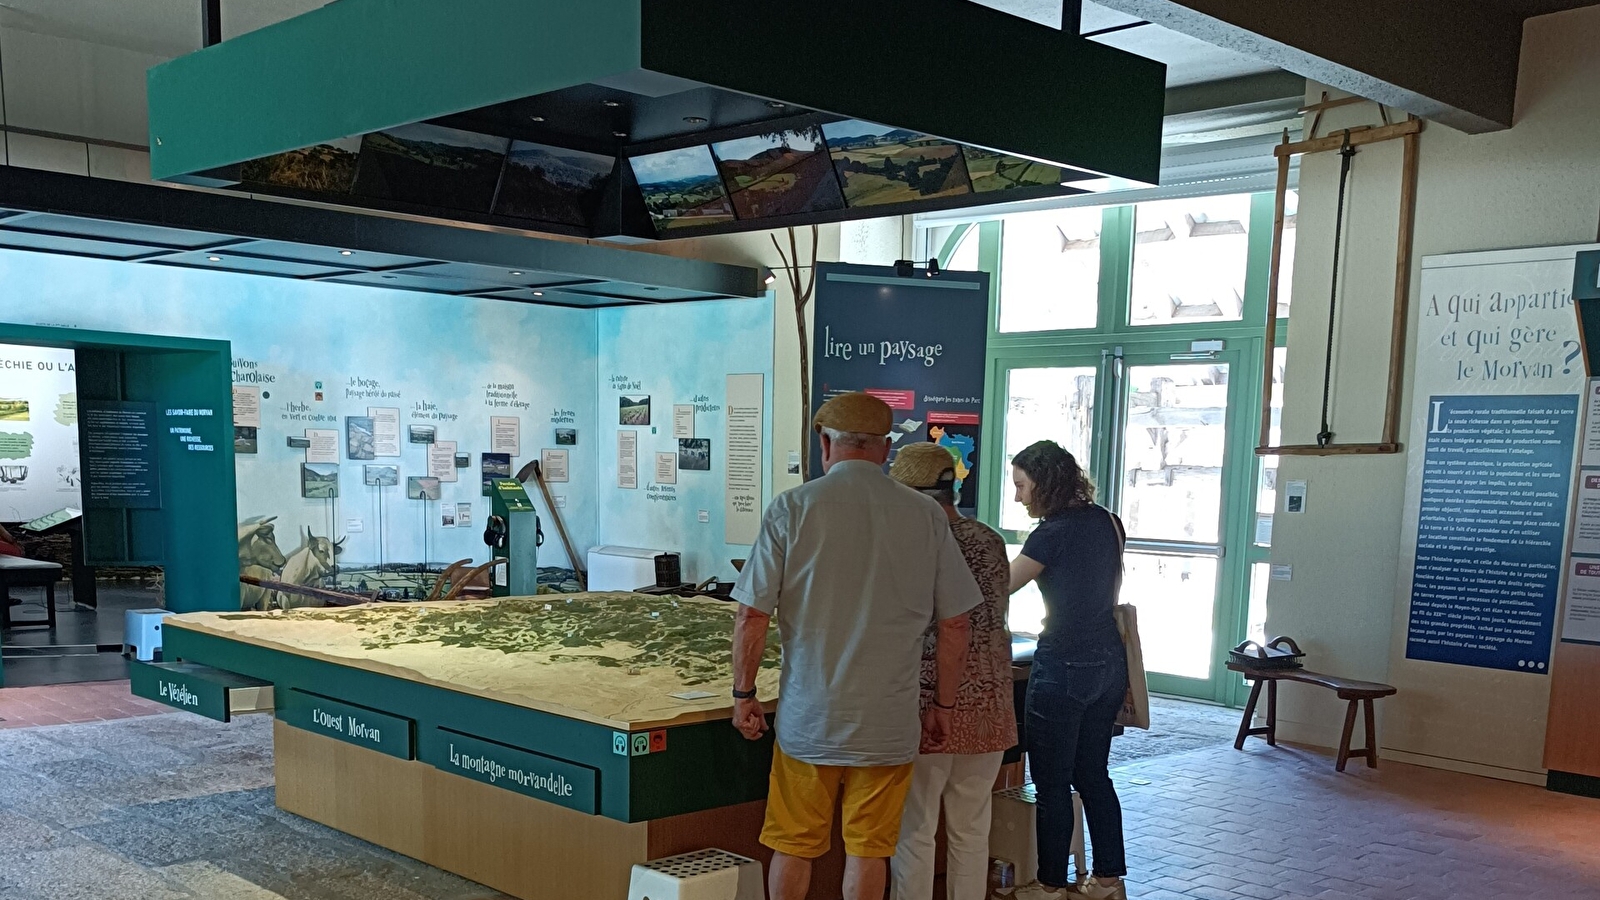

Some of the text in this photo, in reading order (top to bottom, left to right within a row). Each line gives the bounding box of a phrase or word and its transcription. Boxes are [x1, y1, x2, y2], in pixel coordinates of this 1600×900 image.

[1426, 294, 1439, 316] A
[1448, 293, 1480, 322] qui
[824, 325, 943, 367] lire un paysage
[1440, 326, 1557, 354] et qui gère
[37, 361, 53, 371] OU
[58, 362, 75, 372] L'A
[1457, 360, 1474, 380] le
[1482, 360, 1553, 381] Morvan
[159, 680, 198, 706] Le Vézélien
[313, 708, 381, 743] L'Ouest Morvan
[449, 743, 573, 797] La montagne morvandelle
